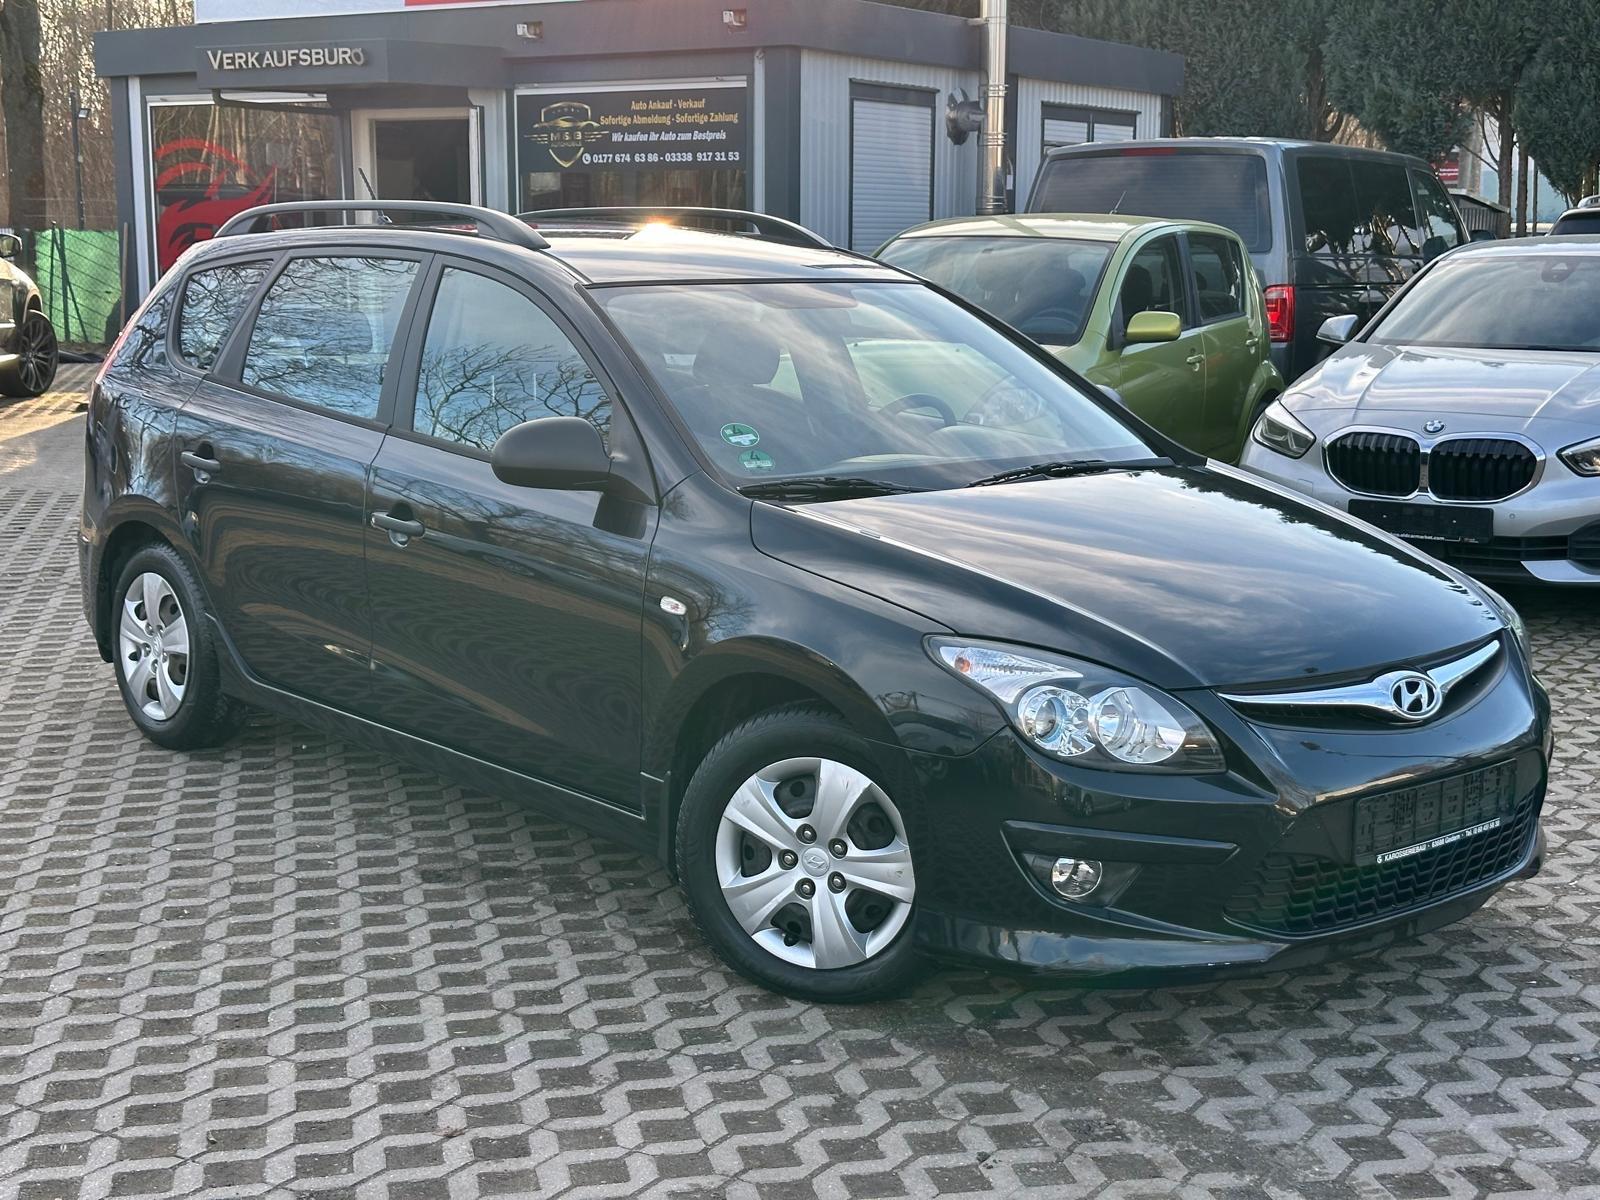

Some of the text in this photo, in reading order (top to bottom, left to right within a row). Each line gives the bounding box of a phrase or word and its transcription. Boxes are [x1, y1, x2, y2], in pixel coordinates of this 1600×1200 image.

[631, 101, 646, 110] Auto
[648, 100, 672, 109] Ankauf
[678, 99, 705, 109] Verkauf
[600, 115, 631, 126] Sofortige
[633, 115, 670, 125] Abmeldung
[676, 113, 708, 124] Sofortige
[710, 113, 738, 124] Zahlung
[612, 132, 623, 142] Wir
[624, 132, 648, 141] kaufen
[660, 131, 676, 141] Auto
[693, 130, 726, 142] Bestpreis
[593, 154, 612, 163] 0177
[615, 154, 630, 162] 674
[635, 153, 646, 162] 63
[647, 153, 658, 162] 86
[665, 152, 692, 161] 03338
[697, 152, 712, 161] 917
[715, 152, 726, 161] 31
[728, 152, 739, 161] 53
